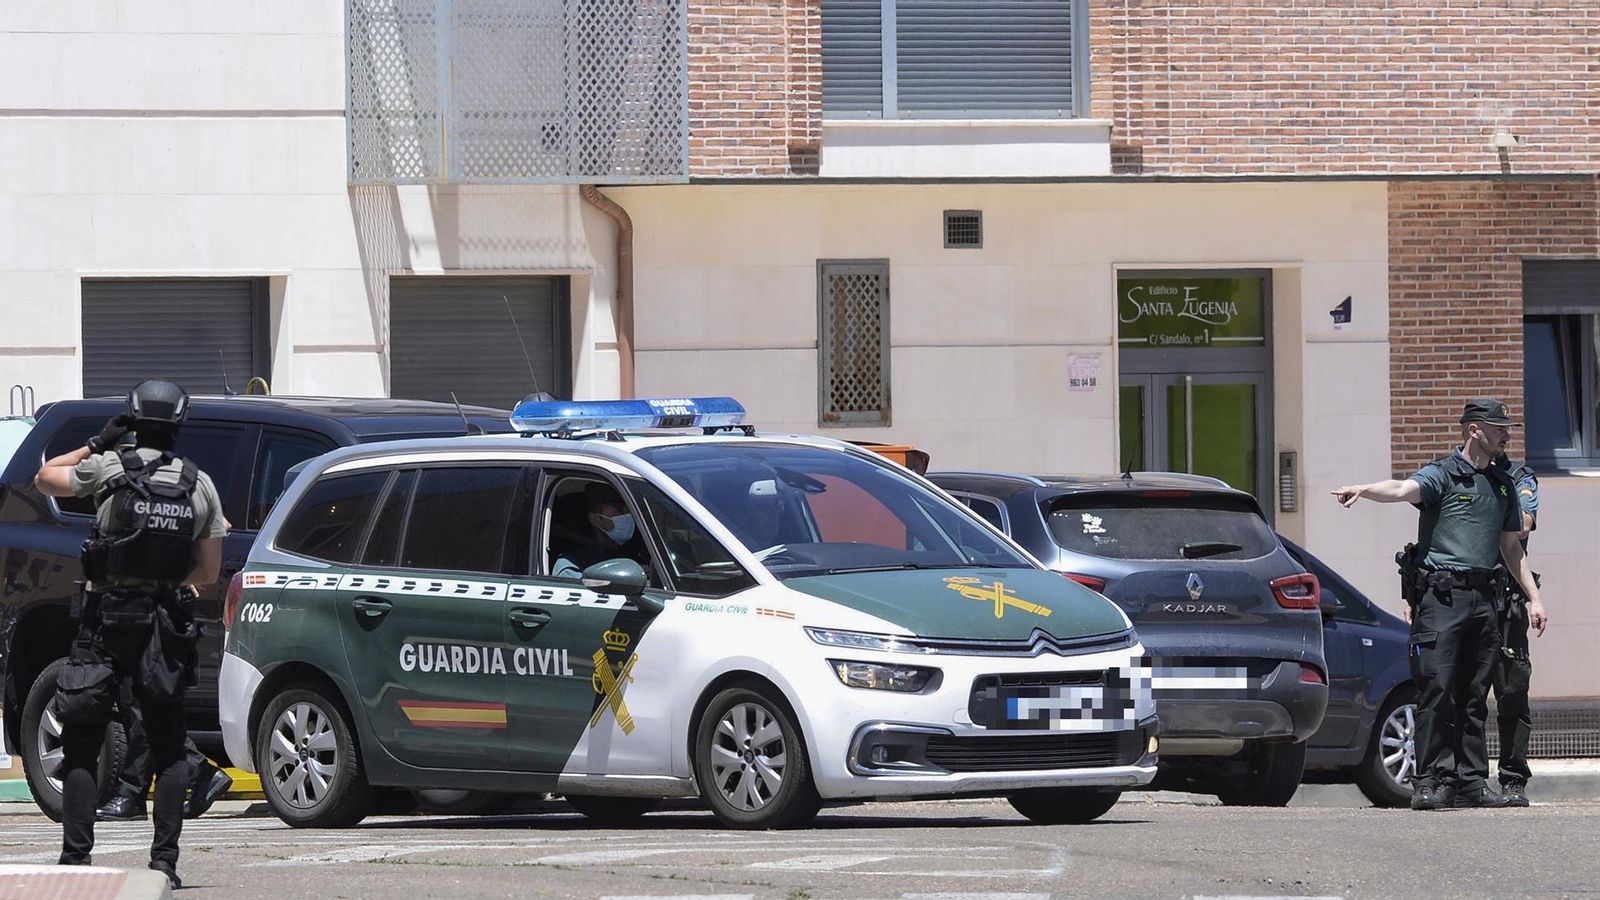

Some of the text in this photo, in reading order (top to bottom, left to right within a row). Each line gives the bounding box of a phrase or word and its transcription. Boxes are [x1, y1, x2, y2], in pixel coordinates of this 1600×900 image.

[1149, 286, 1178, 295] Edificio
[1119, 286, 1238, 325] SANTA EUGENIA
[650, 399, 694, 407] GUARDIA
[663, 406, 691, 415] CIVIL
[134, 501, 193, 519] GUARDIA
[147, 515, 179, 531] CIVIL
[684, 602, 749, 614] GUARDIA CIVIL
[1163, 604, 1227, 613] KADJAR
[399, 642, 574, 676] GUARDIA CIVIL
